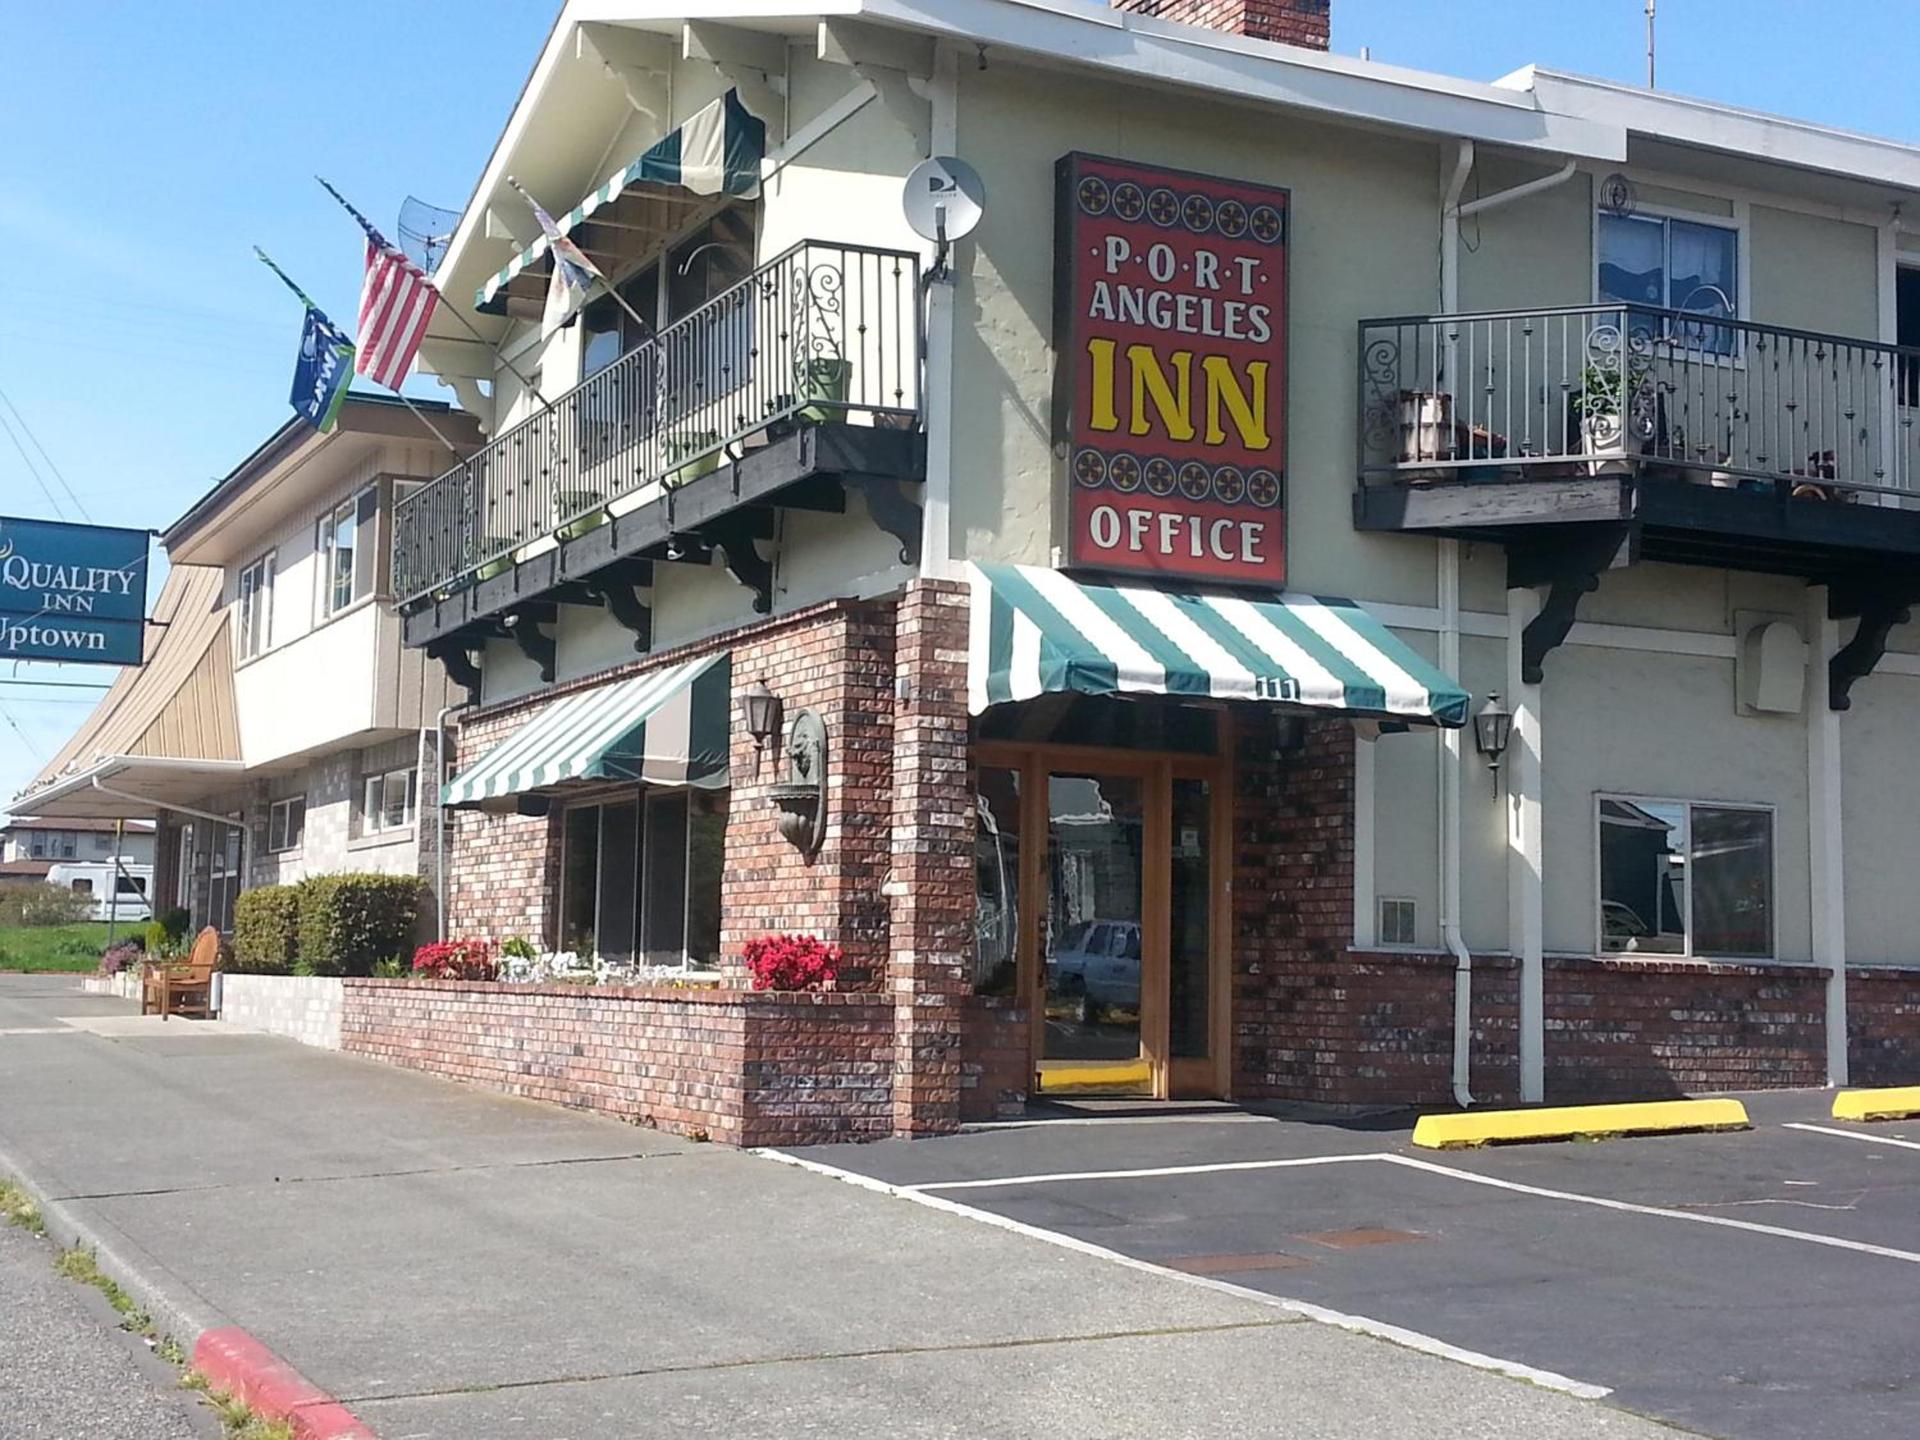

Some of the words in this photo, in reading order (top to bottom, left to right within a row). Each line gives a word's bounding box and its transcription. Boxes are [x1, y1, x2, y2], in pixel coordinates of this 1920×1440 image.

[1088, 280, 1272, 343] ANGELES
[1087, 337, 1271, 450] INN
[1089, 505, 1266, 564] OFFICE
[2, 555, 136, 595] QUALITY
[42, 592, 95, 613] INN
[1257, 676, 1296, 701] 111
